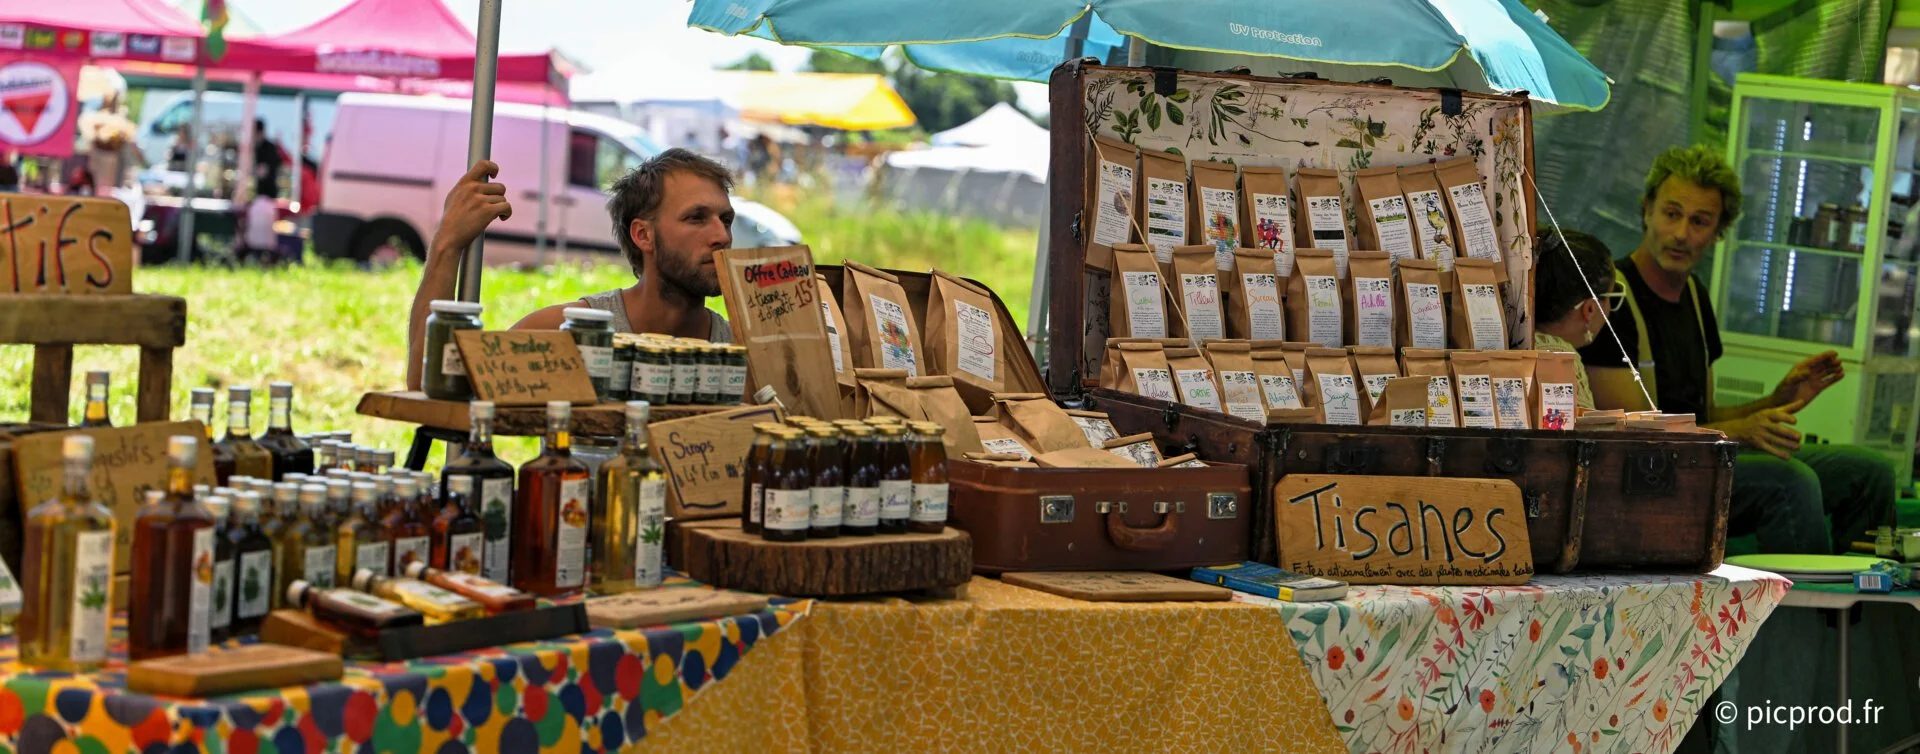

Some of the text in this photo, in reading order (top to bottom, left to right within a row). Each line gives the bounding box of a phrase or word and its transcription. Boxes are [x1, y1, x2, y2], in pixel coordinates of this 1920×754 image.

[1229, 22, 1322, 48] UV Protection
[744, 261, 810, 284] Offre Cadeau
[755, 290, 779, 306] tisane
[1185, 289, 1216, 306] Tilleul
[1248, 288, 1281, 308] Sureau
[1189, 388, 1212, 399] ORTIE
[1320, 388, 1360, 406] Sauge
[669, 431, 714, 466] Sirops
[1288, 481, 1506, 564] Tisanes
[1395, 569, 1416, 577] avec
[1418, 563, 1433, 577] des
[1436, 562, 1463, 583] plantes
